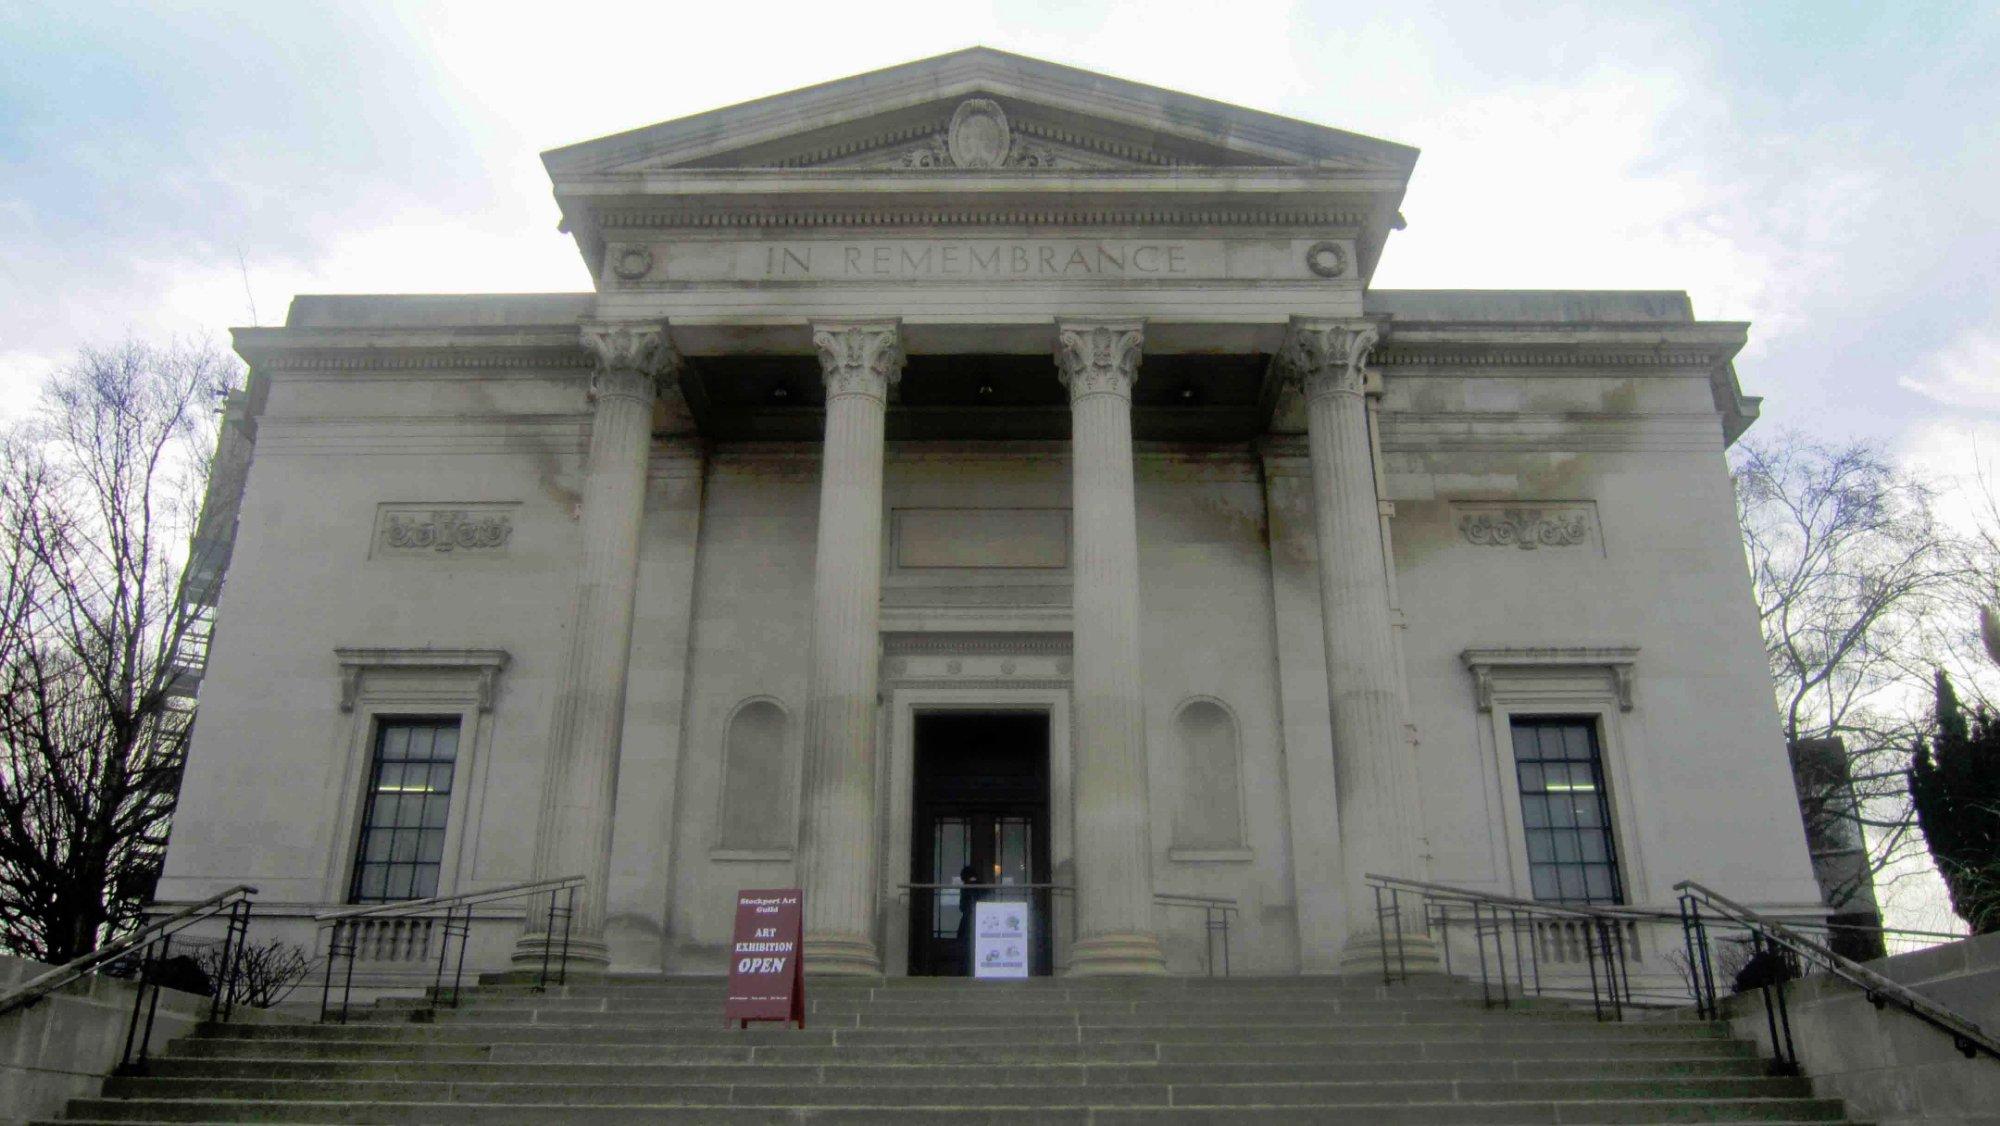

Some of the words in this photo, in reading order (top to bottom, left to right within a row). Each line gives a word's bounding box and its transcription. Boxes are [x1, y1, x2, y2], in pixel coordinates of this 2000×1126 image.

[764, 246, 812, 274] IN
[843, 246, 1188, 274] REMEMBRANCE
[755, 928, 777, 938] ART
[736, 942, 793, 952] EXHIBITION
[738, 957, 786, 973] OPEN
